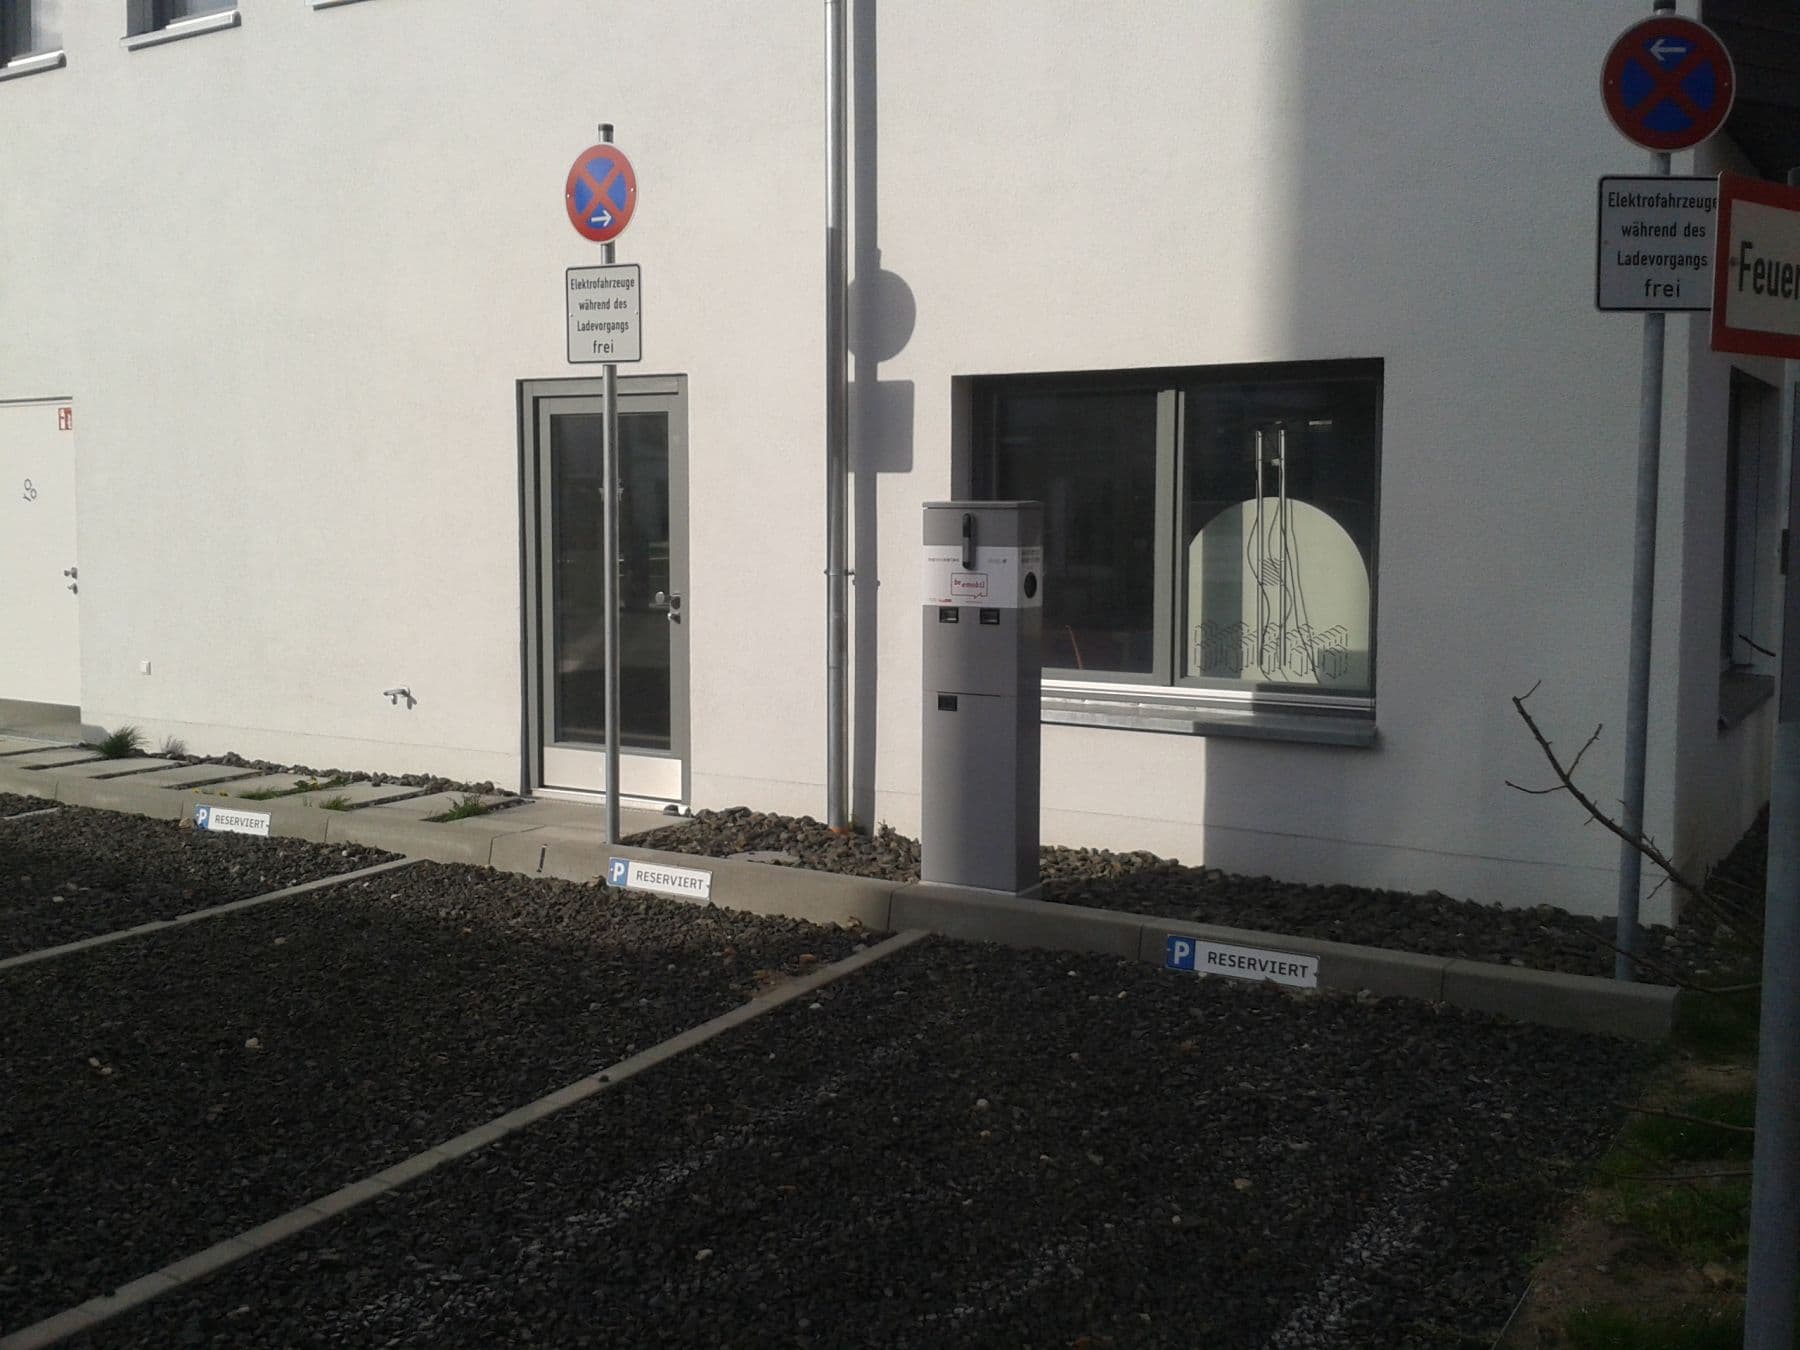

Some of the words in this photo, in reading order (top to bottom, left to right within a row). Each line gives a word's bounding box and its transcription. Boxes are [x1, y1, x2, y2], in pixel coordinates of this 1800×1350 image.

[1621, 221, 1676, 238] während
[1683, 221, 1706, 238] des
[1617, 251, 1708, 270] Ladevorgangs
[570, 276, 635, 290] Elektrofahrzeuge
[1644, 279, 1681, 297] frei
[578, 298, 611, 311] während
[613, 297, 628, 310] des
[577, 320, 629, 333] Ladevorgangs
[593, 340, 614, 354] frei
[198, 808, 208, 825] P
[214, 814, 265, 829] RESERVIERT
[613, 862, 625, 882] P
[636, 870, 704, 890] RESERVIERT
[1173, 940, 1190, 965] P
[1207, 951, 1309, 978] RESERVIERT
